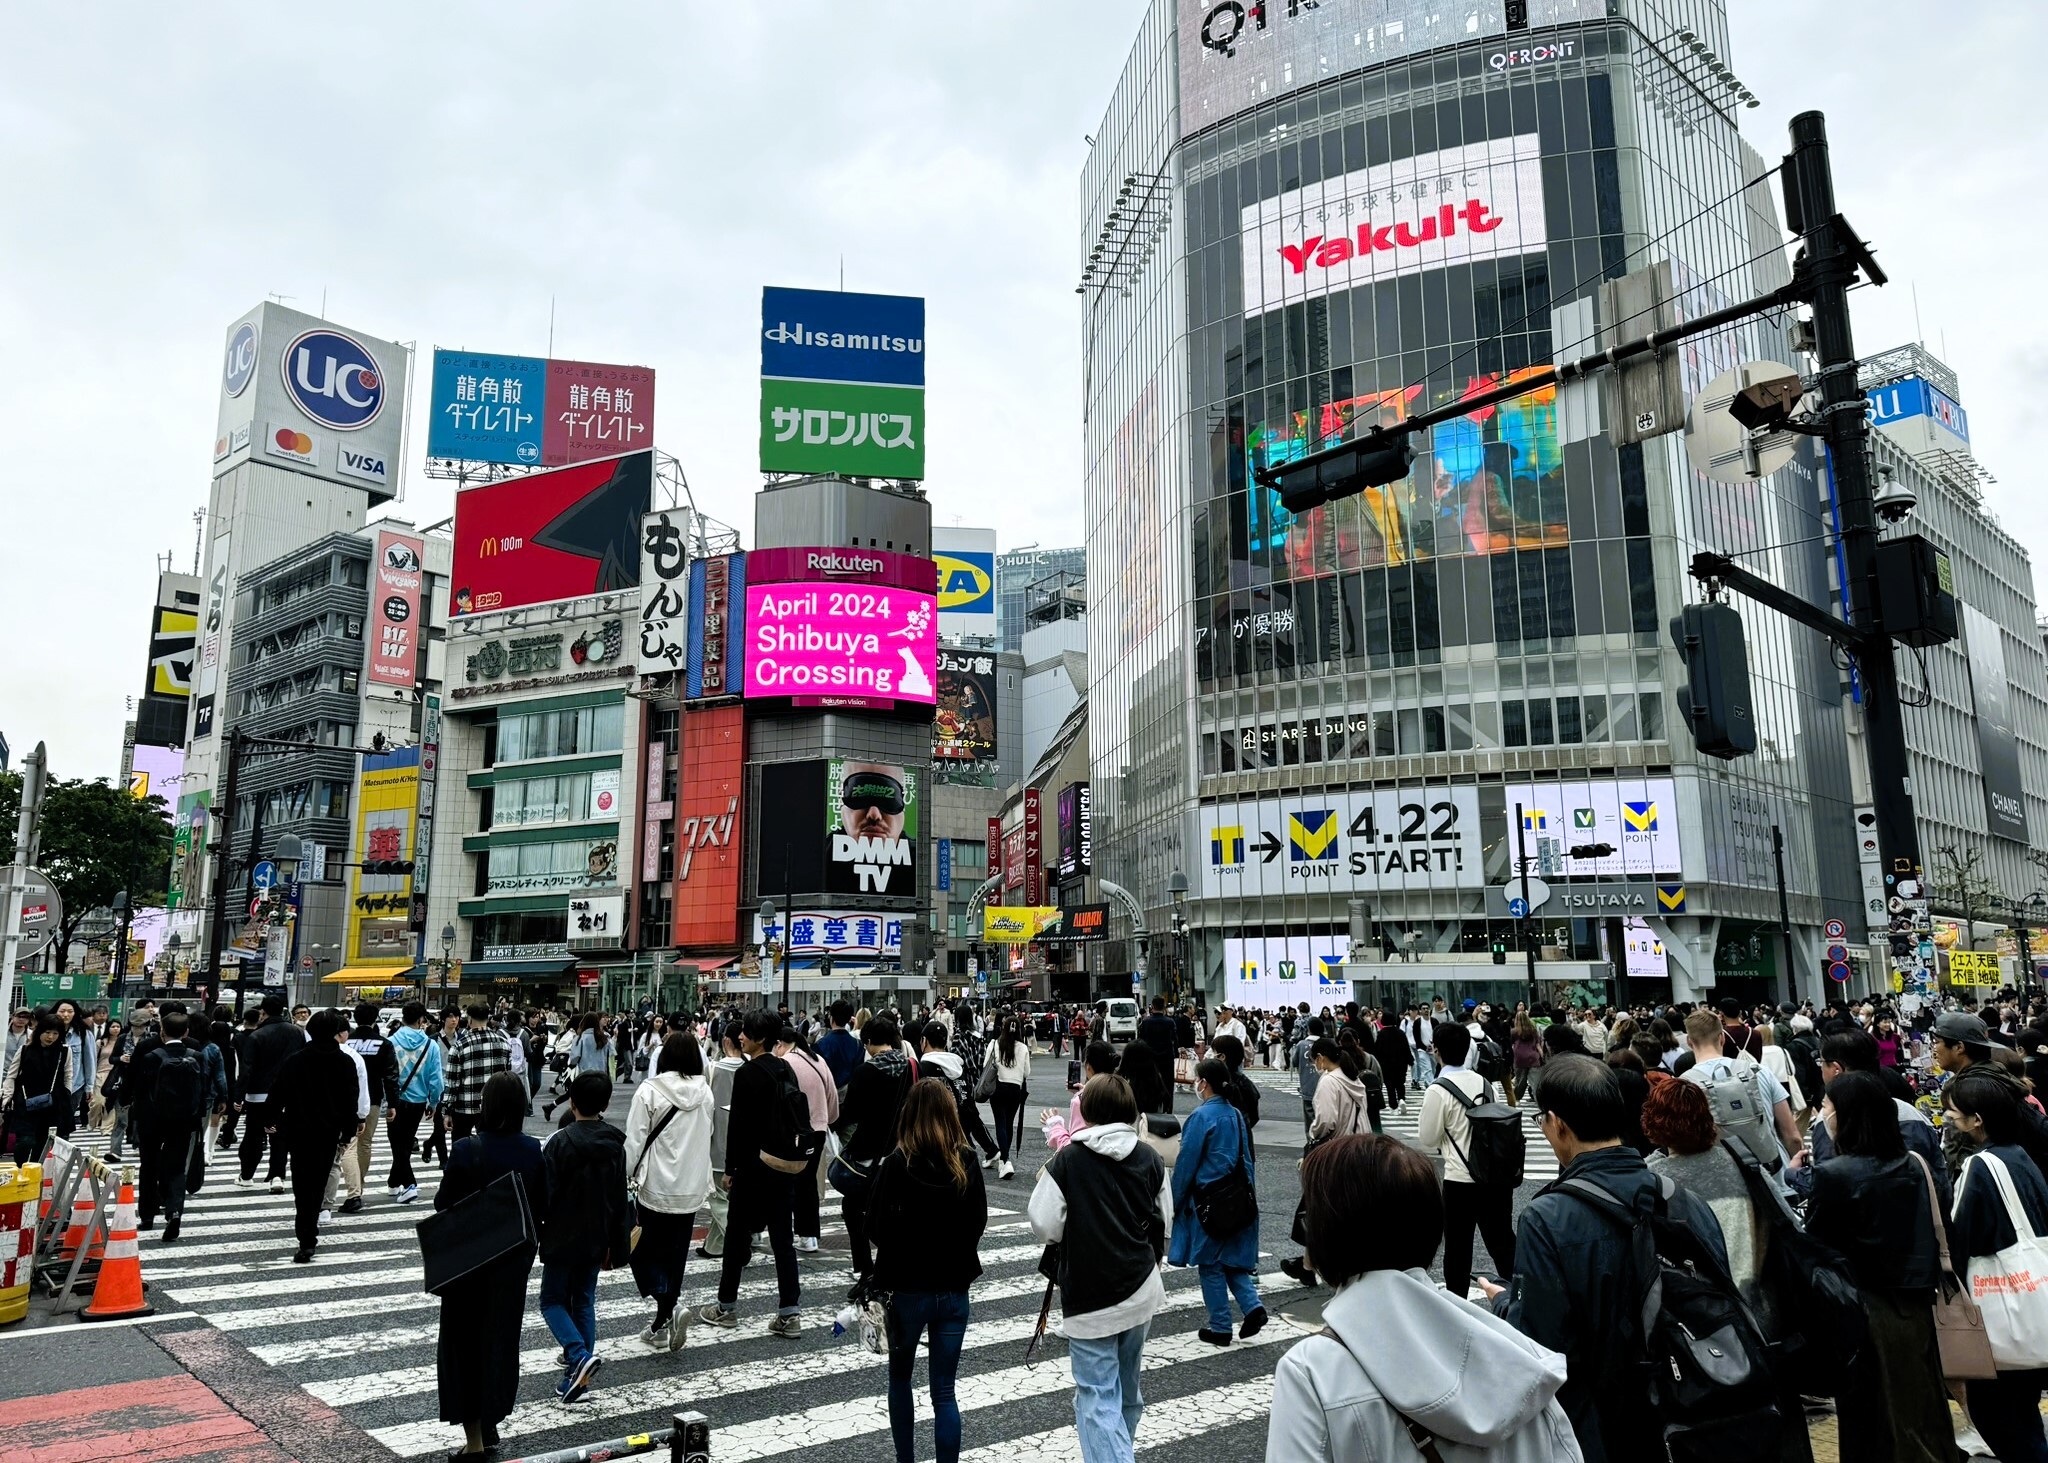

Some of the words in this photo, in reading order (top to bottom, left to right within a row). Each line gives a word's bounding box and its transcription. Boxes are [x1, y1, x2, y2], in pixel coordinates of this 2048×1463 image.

[1490, 41, 1575, 70] QFRONT
[1277, 198, 1503, 275] Yakult
[764, 321, 922, 353] Hisamitsu
[441, 356, 540, 373] のど、直接、うるおう
[553, 365, 650, 383] のど、直接、うるおう
[456, 374, 523, 404] 龍角散
[569, 383, 634, 415] 龍角散
[444, 403, 534, 433] ダイレクト
[558, 411, 645, 442] ダイレクト
[771, 406, 915, 450] サロンパス
[341, 450, 385, 475] VISA
[519, 447, 538, 457] 生薬
[501, 536, 523, 553] 100m
[808, 553, 884, 574] Rakuten
[1006, 554, 1043, 566] HULIC
[641, 513, 686, 668] もんじゃ
[758, 593, 817, 620] April
[828, 593, 891, 618] 2024
[757, 624, 880, 656] Shibuya
[756, 658, 892, 692] Crossing
[199, 706, 211, 724] 7F
[822, 698, 847, 706] Rakuten
[1262, 727, 1308, 743] SHARE
[1992, 791, 2023, 818] CHANEL
[1027, 797, 1039, 858] カラオケ
[1347, 801, 1461, 844] 4.22
[680, 796, 739, 880] クスリ
[832, 834, 912, 866] DMM
[1625, 834, 1659, 843] POINT
[1212, 867, 1246, 875] T-POINT
[1291, 864, 1339, 878] POINT
[1348, 848, 1463, 875] START!
[853, 864, 892, 892] TV
[989, 866, 999, 905] カオ
[570, 901, 589, 911] うなぎ
[1562, 893, 1645, 907] TSUTAYA
[577, 912, 608, 931] 松川
[763, 919, 901, 946] 大盛堂書店
[1951, 953, 1973, 967] イエス
[1976, 953, 1998, 968] 天国
[1953, 968, 1975, 984] 不信
[1978, 969, 2001, 985] 地獄
[1319, 986, 1346, 995] POINT
